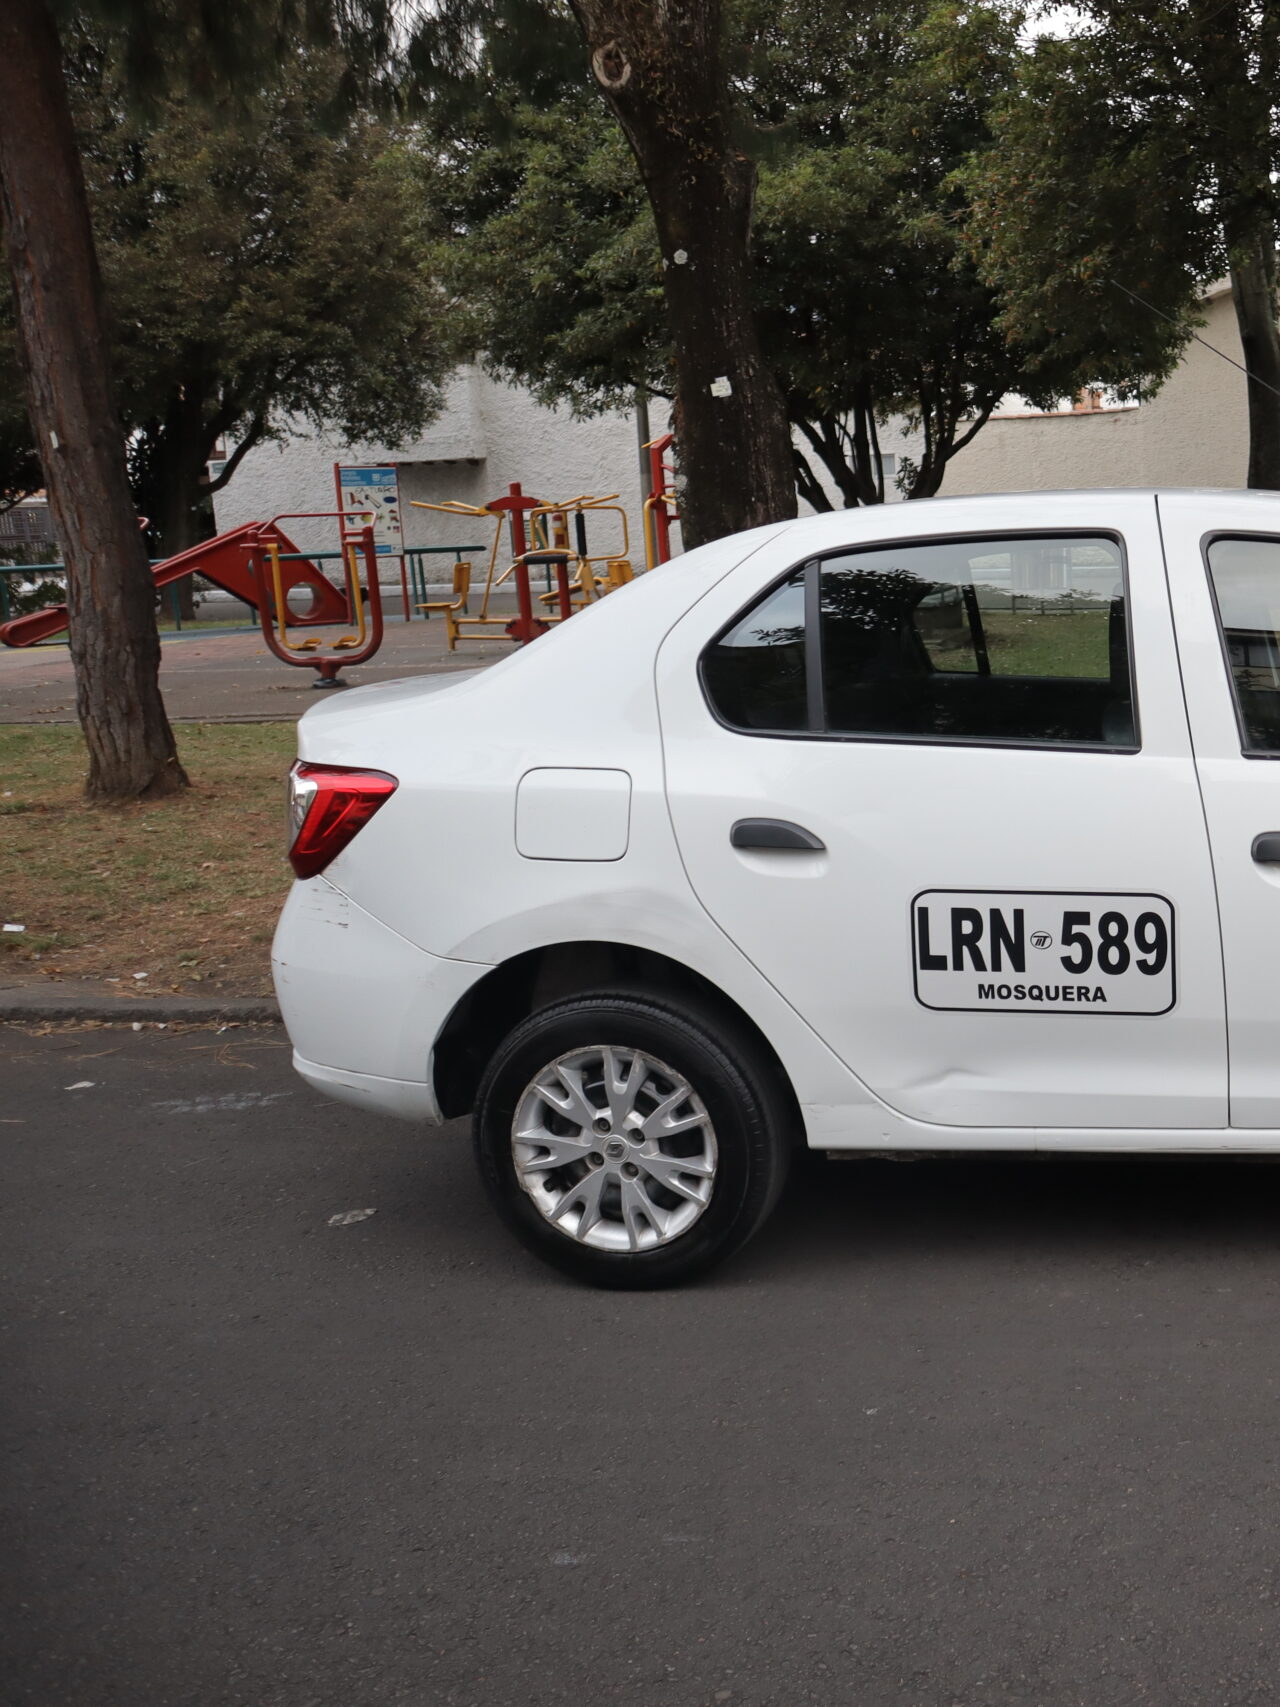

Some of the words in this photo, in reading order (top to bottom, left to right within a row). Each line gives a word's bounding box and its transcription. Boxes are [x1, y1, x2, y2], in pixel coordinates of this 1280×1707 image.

[917, 906, 1026, 973] LRN
[1060, 911, 1168, 976] 589
[977, 983, 1108, 1003] MOSQUERA
